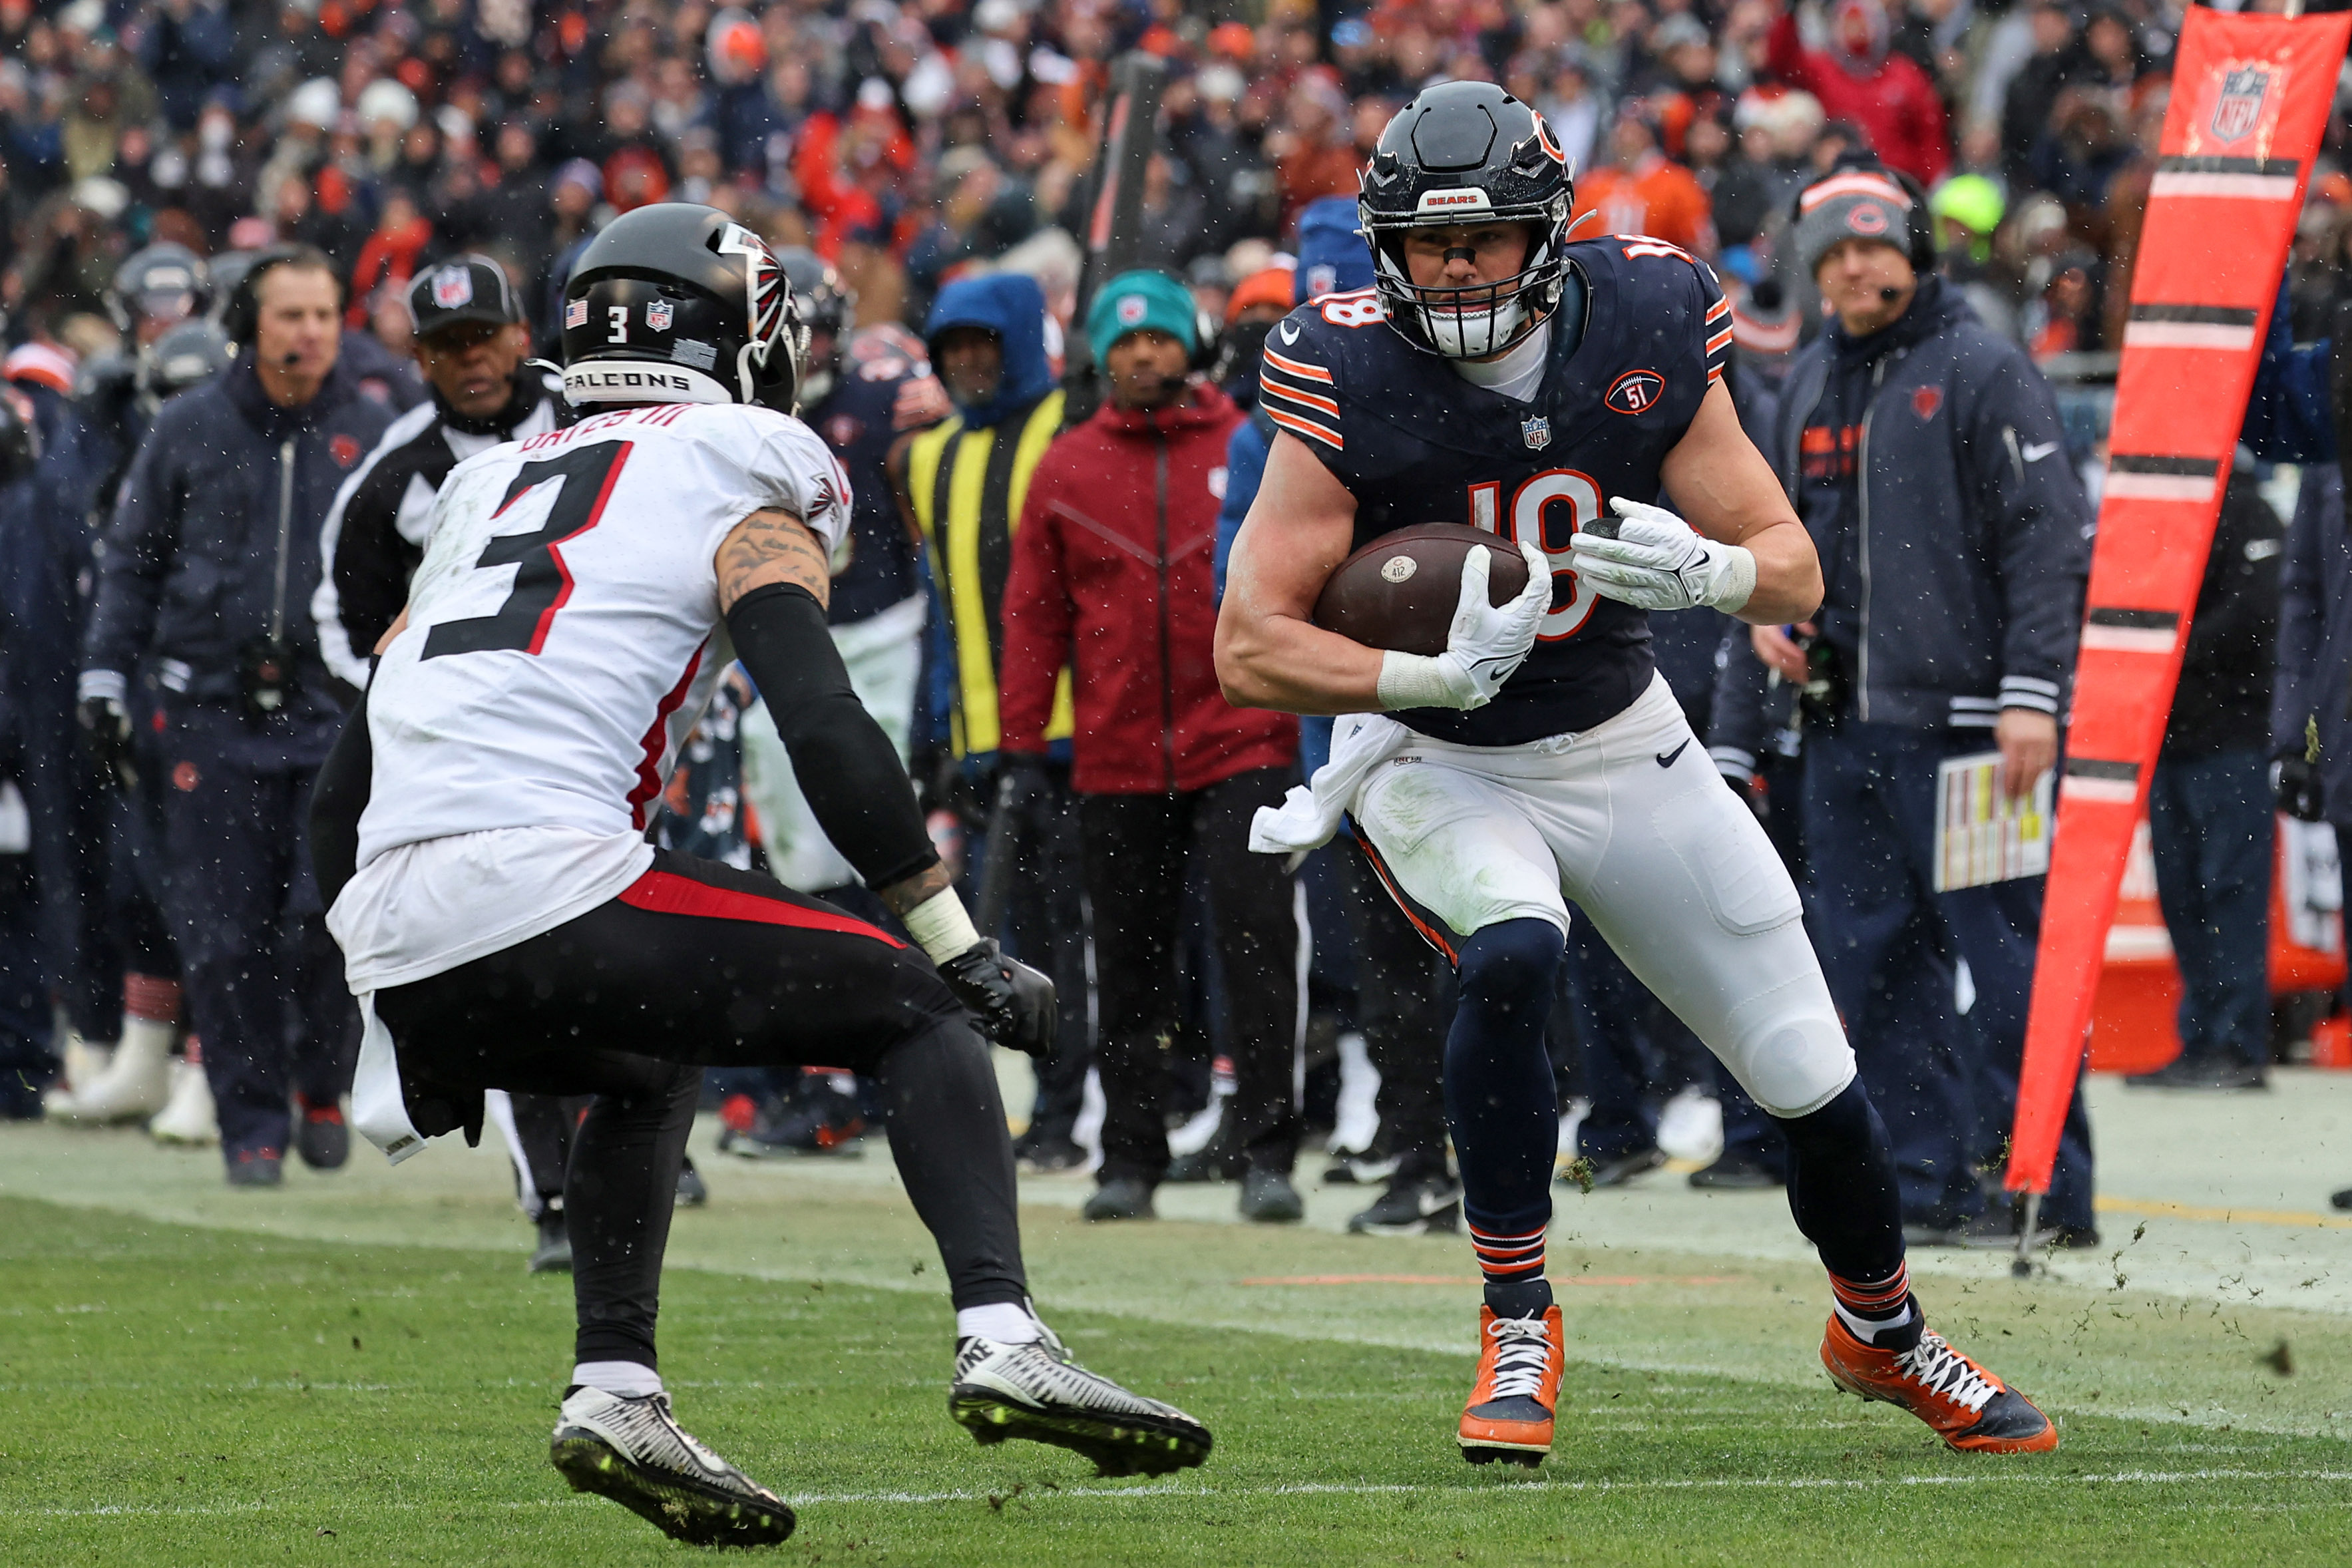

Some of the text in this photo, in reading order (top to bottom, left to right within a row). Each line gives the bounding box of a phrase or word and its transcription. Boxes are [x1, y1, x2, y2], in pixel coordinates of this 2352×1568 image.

[1427, 196, 1477, 206] BEARS
[608, 306, 629, 343] 3
[566, 373, 690, 391] FALCONS
[1625, 383, 1648, 409] 51
[1528, 431, 1547, 444] NFL
[419, 440, 634, 662] 3
[1392, 566, 1406, 578] 412
